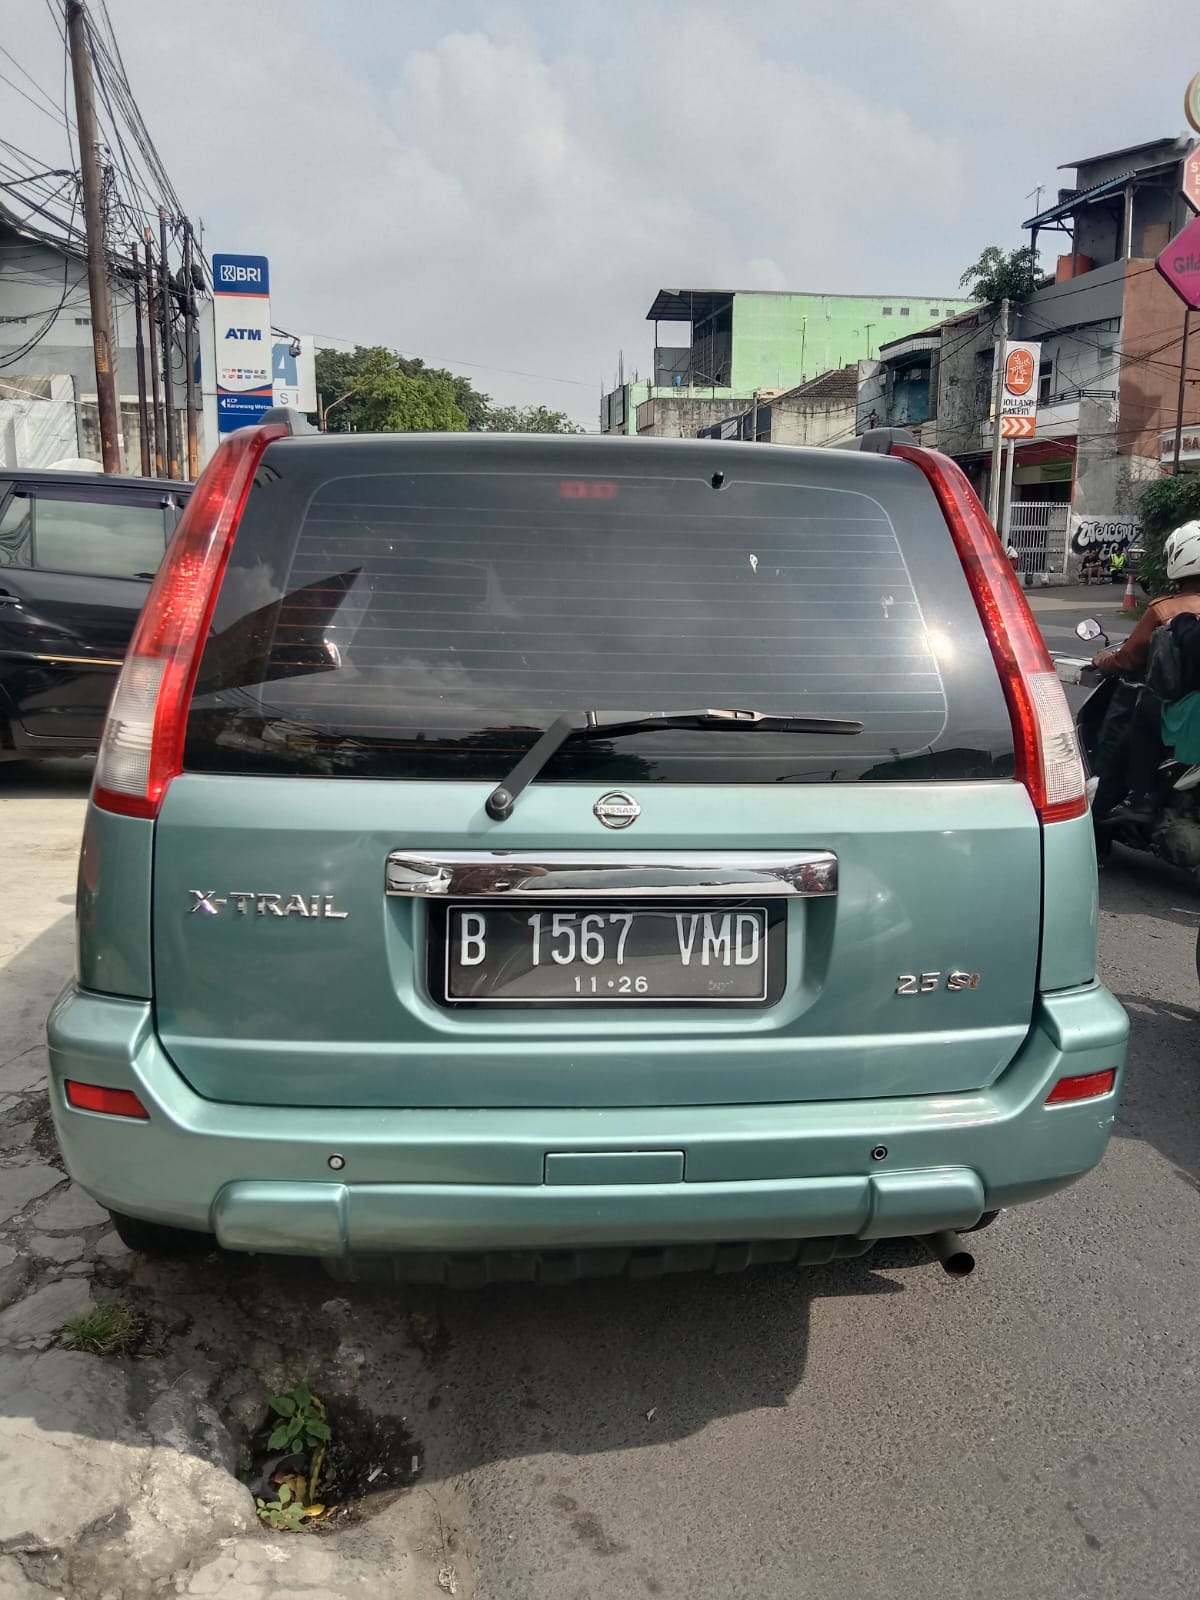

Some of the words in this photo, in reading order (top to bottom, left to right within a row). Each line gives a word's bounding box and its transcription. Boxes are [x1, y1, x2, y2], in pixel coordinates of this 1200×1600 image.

[236, 266, 262, 282] BRI
[225, 328, 262, 341] ATM
[599, 806, 637, 814] NISSAN
[188, 889, 349, 918] X-TRAIL
[460, 913, 487, 966] B
[528, 913, 634, 966] 1567
[675, 914, 760, 966] VMD
